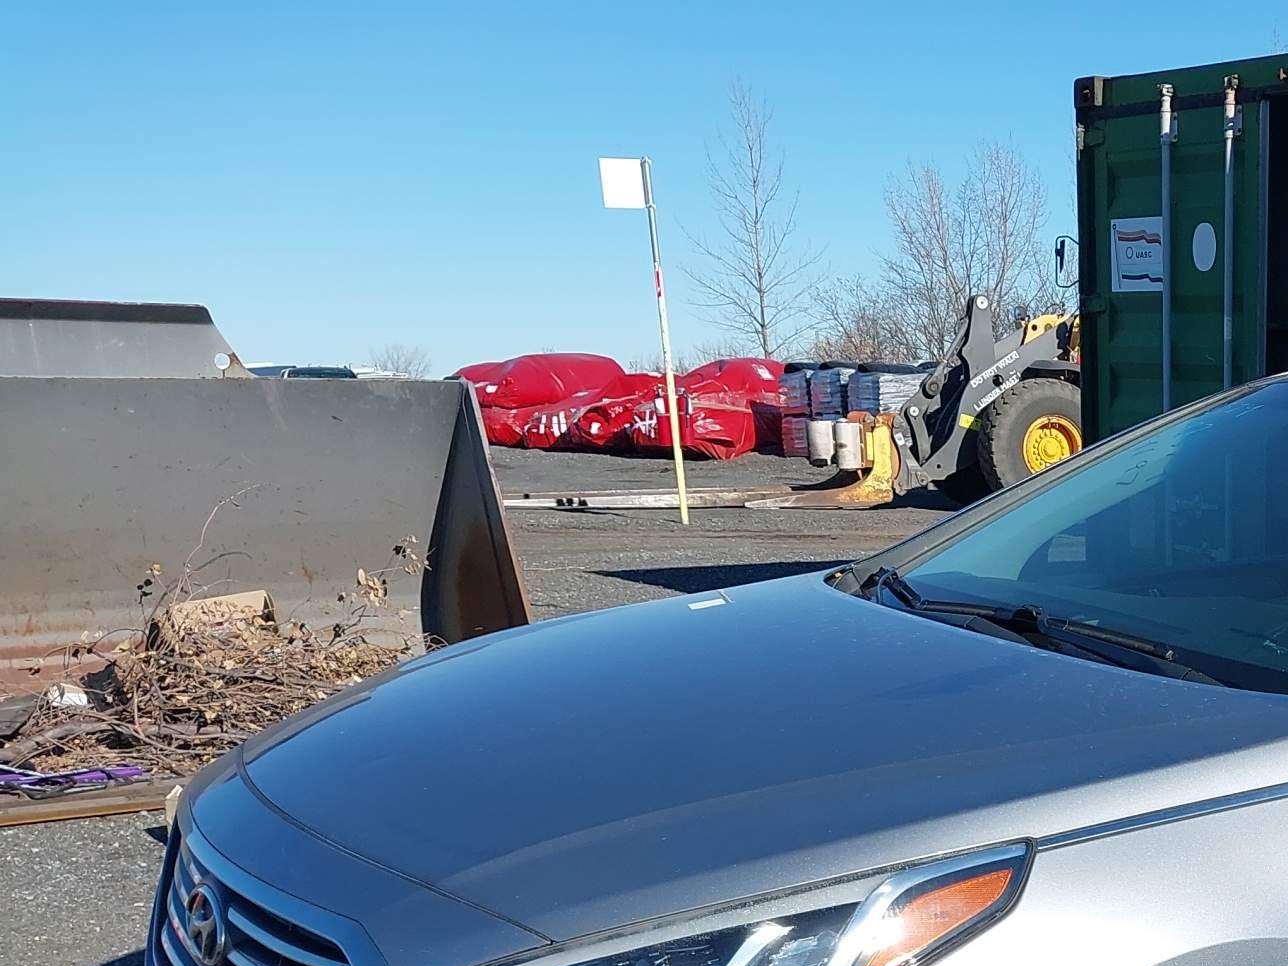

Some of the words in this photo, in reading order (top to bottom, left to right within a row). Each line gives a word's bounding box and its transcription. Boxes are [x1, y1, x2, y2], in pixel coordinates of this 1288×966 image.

[1136, 250, 1153, 259] UASC
[970, 376, 984, 388] DO
[982, 365, 998, 380] NOT
